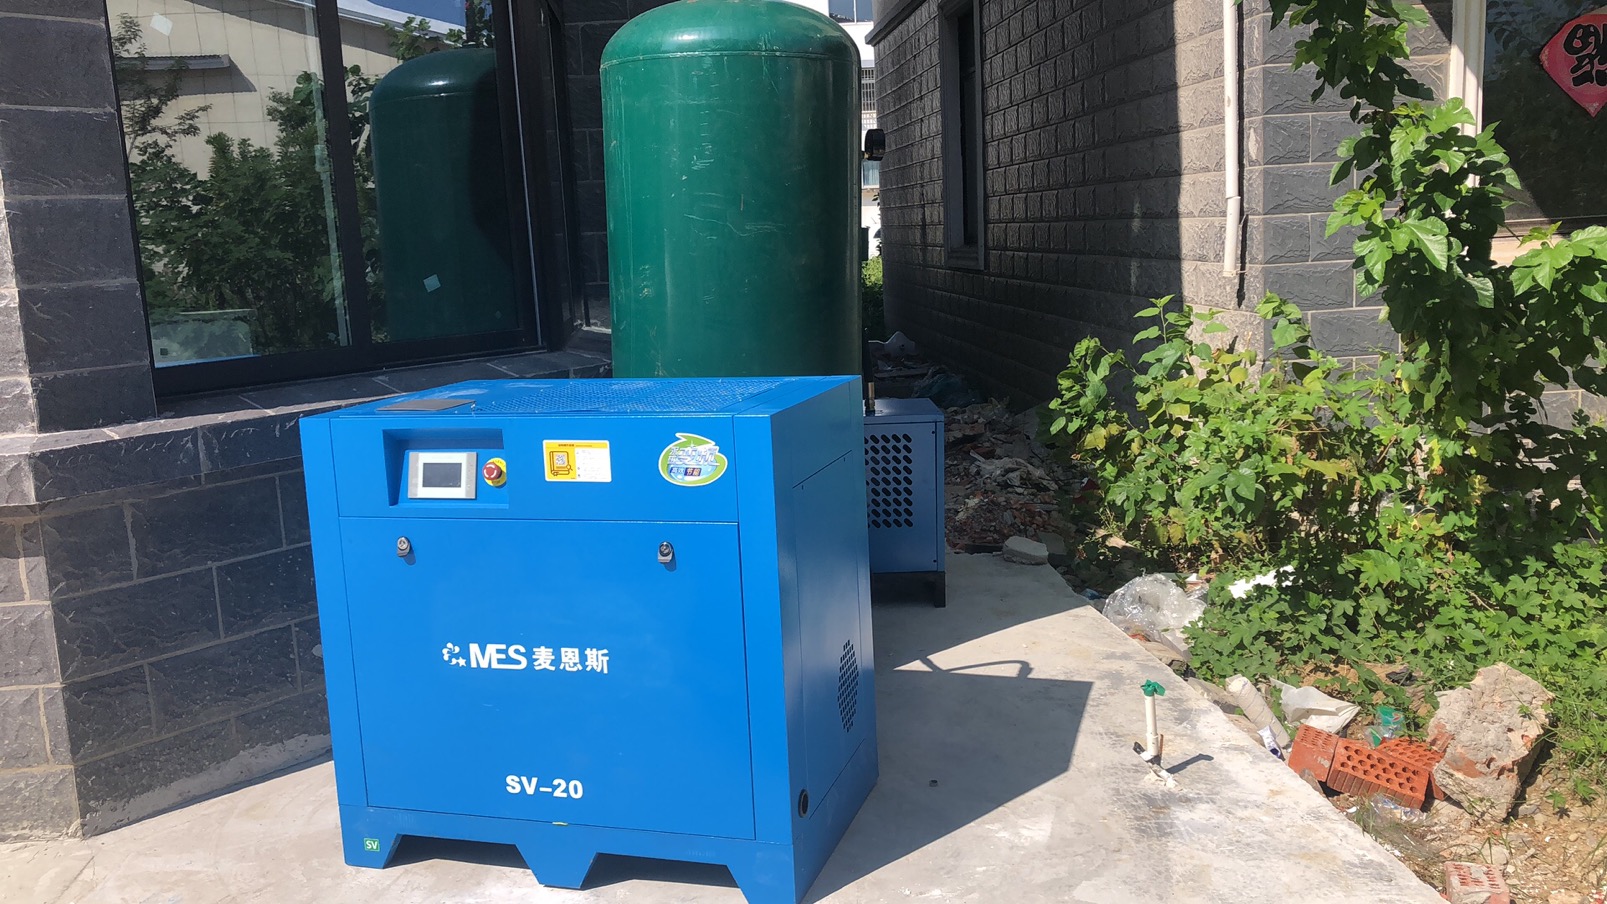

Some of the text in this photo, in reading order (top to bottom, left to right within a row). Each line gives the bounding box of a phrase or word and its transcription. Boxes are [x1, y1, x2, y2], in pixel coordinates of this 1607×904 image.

[469, 642, 609, 674] MES 麦恩斯
[505, 774, 584, 799] SV-20
[365, 840, 378, 850] SV
